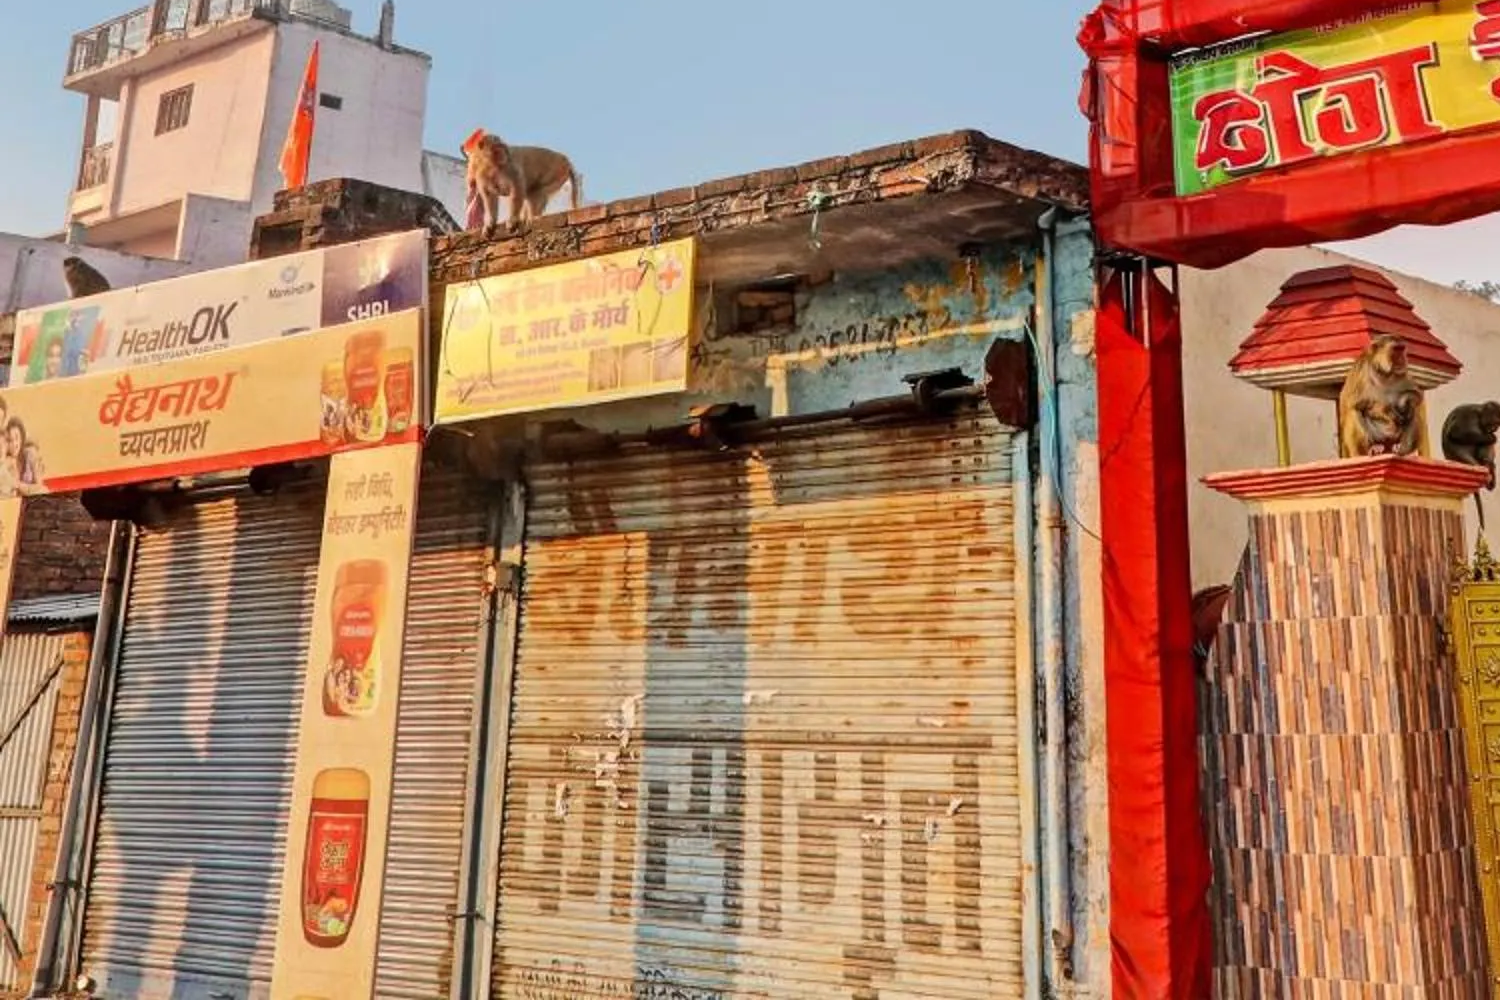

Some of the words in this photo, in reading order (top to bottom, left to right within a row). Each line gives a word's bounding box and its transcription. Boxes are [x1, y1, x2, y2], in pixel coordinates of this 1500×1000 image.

[116, 301, 239, 357] HealthOK
[99, 370, 239, 429] बैद्यनाथ
[119, 419, 210, 458] च्यवनप्राश
